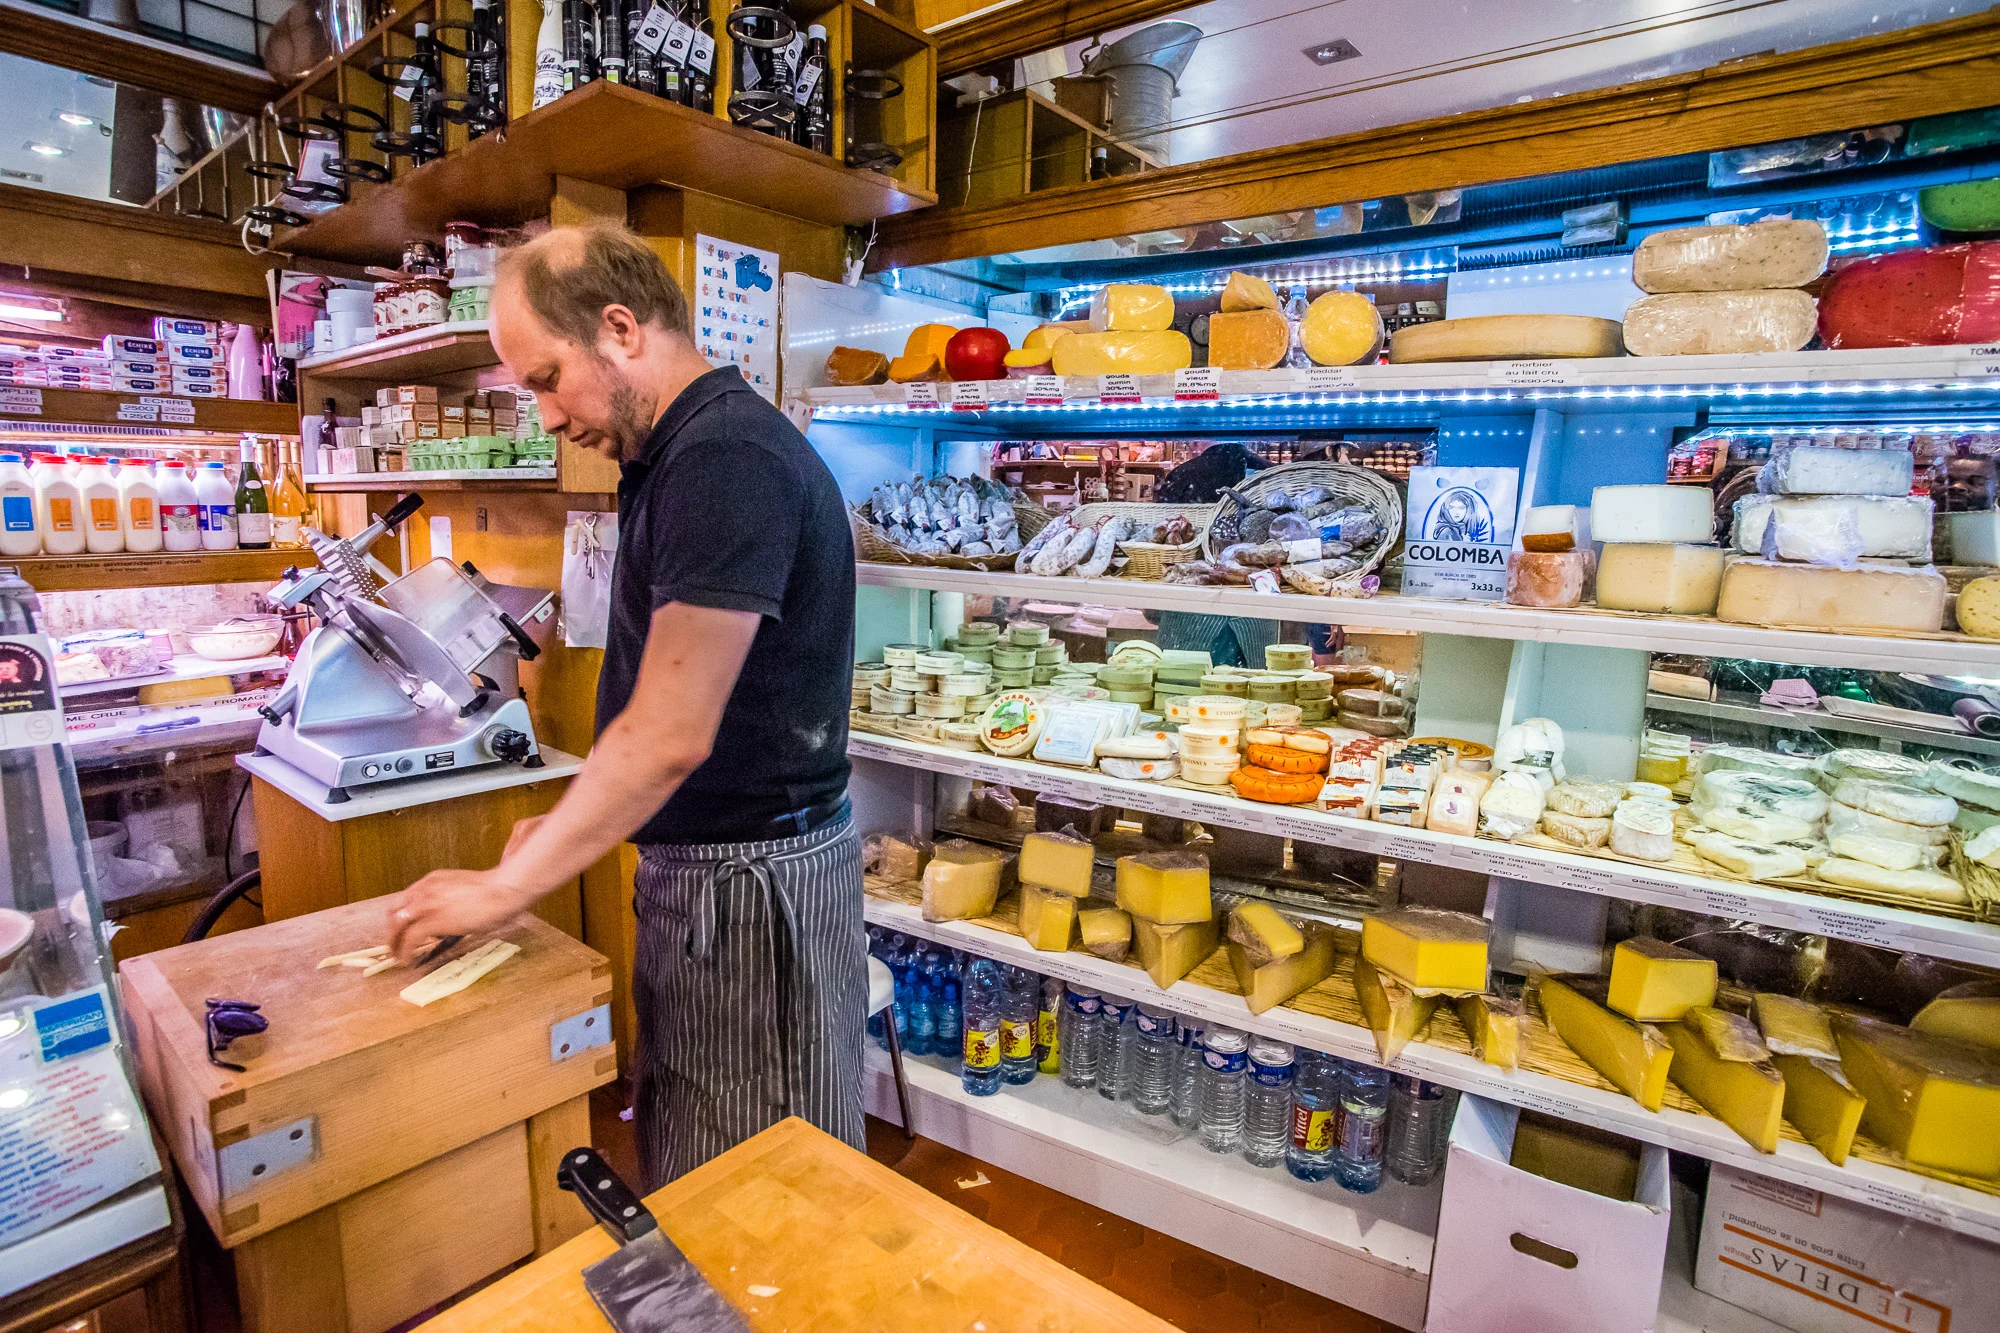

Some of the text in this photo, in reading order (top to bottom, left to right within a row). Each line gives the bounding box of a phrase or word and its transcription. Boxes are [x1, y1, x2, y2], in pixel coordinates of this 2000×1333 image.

[721, 331, 738, 342] can
[144, 397, 189, 406] ECHIRE
[124, 404, 154, 412] 250G
[1408, 545, 1504, 565] COLOMBA
[1470, 582, 1493, 592] 3x33
[214, 694, 269, 706] FROMAGE
[994, 693, 1034, 708] LIVAROT
[91, 710, 127, 718] CRUE
[1275, 816, 1298, 824] pavin
[1394, 836, 1437, 848] maroilles
[1508, 856, 1546, 868] nantais
[1556, 864, 1613, 878] neufchatel
[1572, 873, 1592, 881] aop
[1632, 878, 1679, 890] gaperon
[1692, 888, 1747, 902] chaource
[1808, 908, 1888, 926] coulommier
[1817, 915, 1876, 929] fougerus
[1847, 926, 1868, 934] cru
[1479, 1080, 1509, 1090] comte
[1528, 1093, 1552, 1102] mois
[1556, 1100, 1578, 1109] mini
[1294, 1107, 1308, 1140] Vittel
[1728, 1214, 1777, 1237] comprend
[1780, 1232, 1792, 1240] se
[1795, 1236, 1808, 1247] on
[1810, 1240, 1834, 1258] pros
[1836, 1253, 1866, 1271] Entre
[1752, 1247, 1912, 1325] LE DELAS
